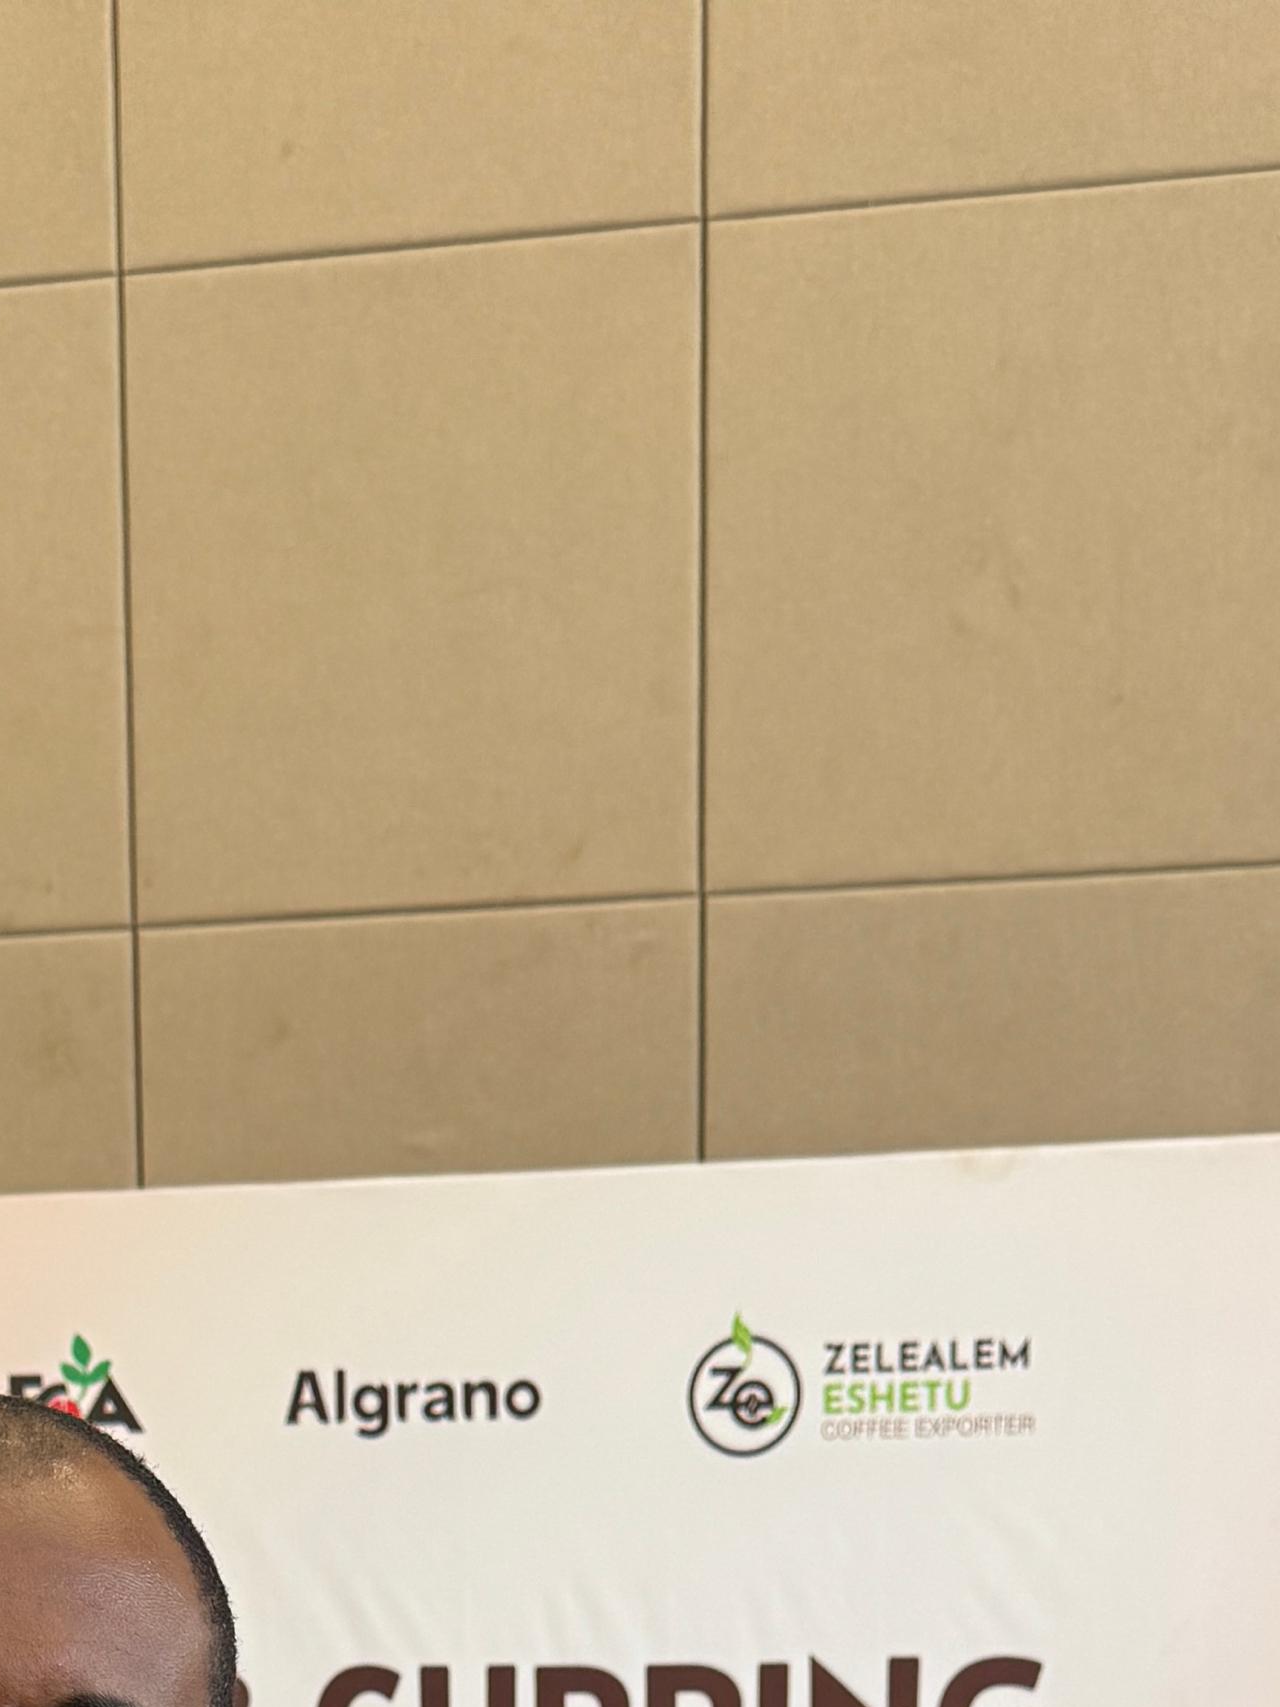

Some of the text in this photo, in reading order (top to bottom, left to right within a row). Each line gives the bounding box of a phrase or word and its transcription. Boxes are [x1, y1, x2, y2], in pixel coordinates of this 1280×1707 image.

[824, 1337, 1032, 1375] ZELEALEM
[285, 1369, 541, 1439] Algrano
[823, 1379, 972, 1414] ESHETU
[821, 1413, 1036, 1442] COFFEE EXPORTER
